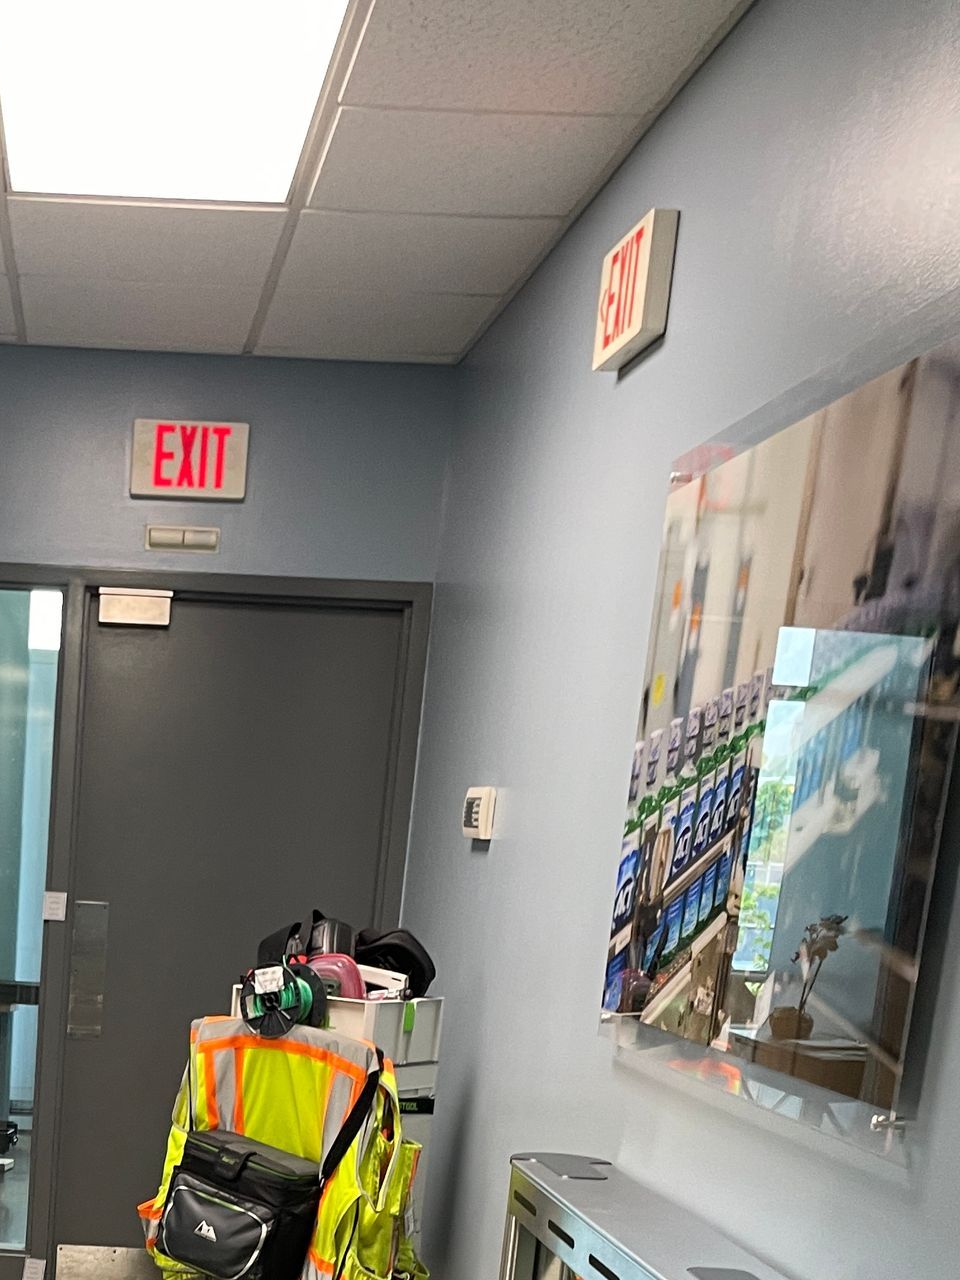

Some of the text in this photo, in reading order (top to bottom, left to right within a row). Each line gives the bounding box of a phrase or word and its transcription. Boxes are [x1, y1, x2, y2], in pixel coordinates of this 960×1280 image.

[603, 226, 644, 350] EXIT
[153, 424, 232, 488] EXIT
[674, 832, 691, 861] ACT
[614, 879, 634, 919] ACT
